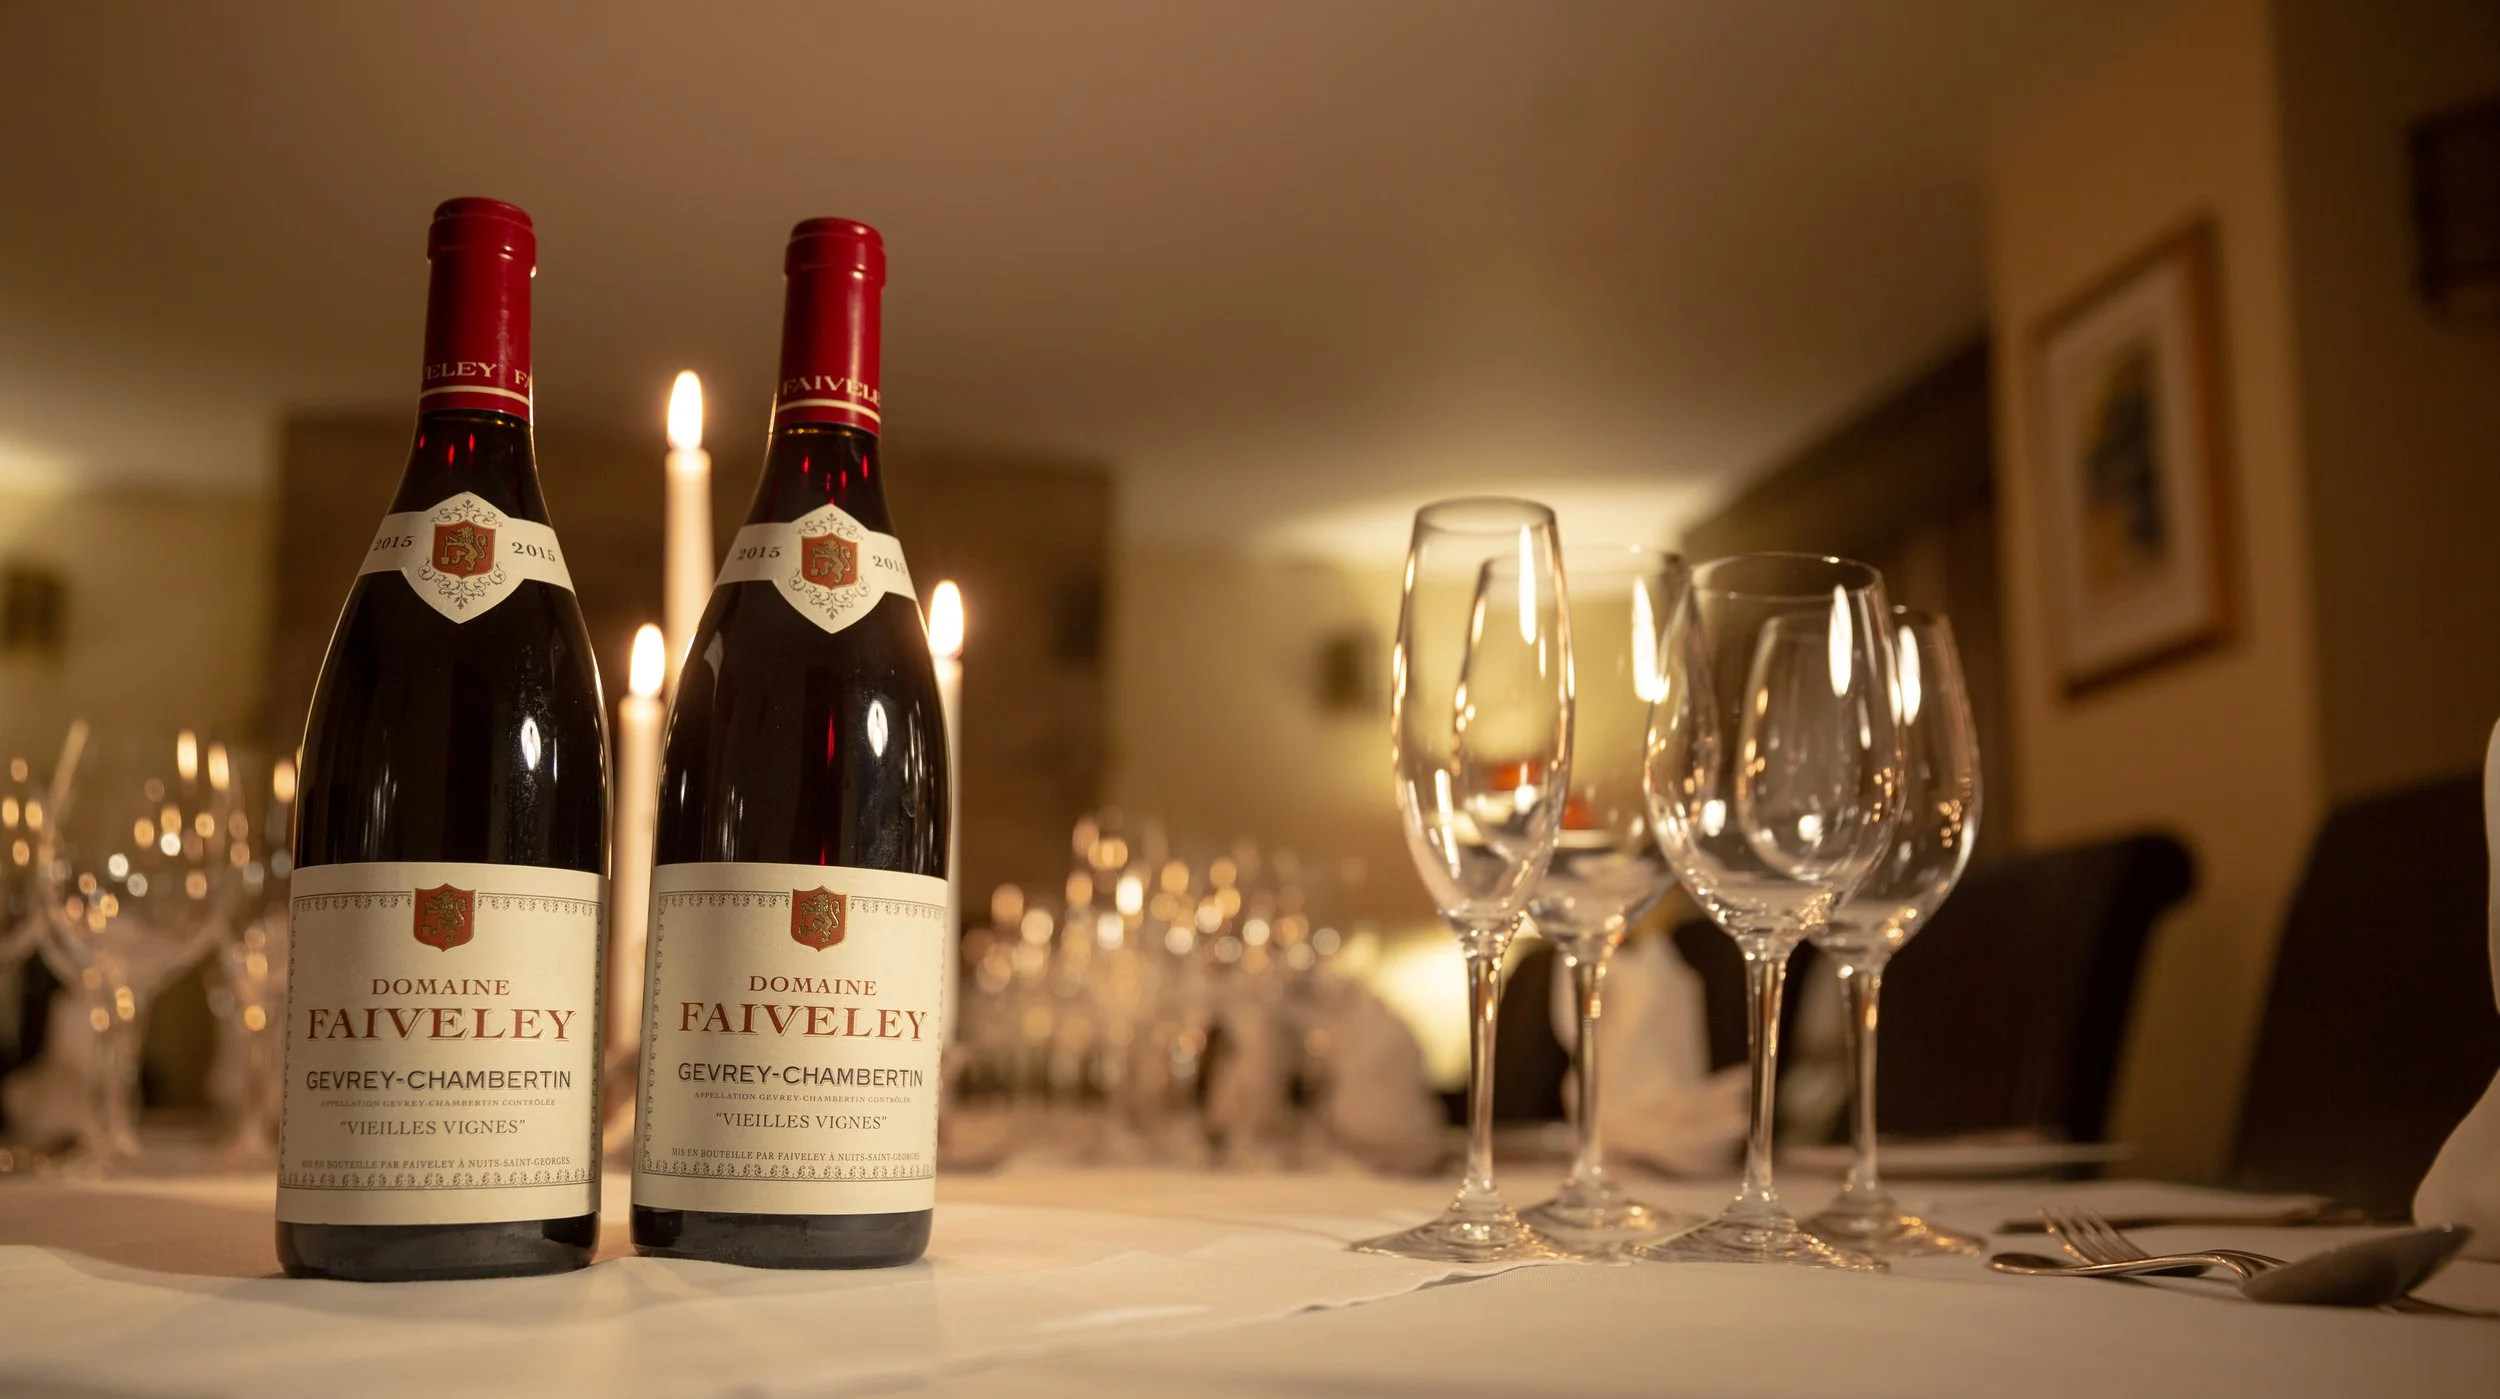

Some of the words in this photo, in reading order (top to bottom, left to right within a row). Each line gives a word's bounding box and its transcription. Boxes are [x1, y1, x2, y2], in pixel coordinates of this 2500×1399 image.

[375, 535, 415, 551] 2015
[511, 541, 556, 562] 2015
[737, 545, 781, 561] 2015
[371, 978, 511, 996] DOMAINE
[749, 975, 877, 996] DOMAINE
[306, 1007, 576, 1042] FAIVELEY
[678, 1002, 928, 1042] FAIVELEY
[306, 1070, 572, 1091] GEVREY-CHAMBERTIN
[678, 1062, 924, 1088] GEVREY-CHAMBERTIN
[382, 1099, 499, 1108] GEVREY-CHAMBERTIN
[694, 1091, 756, 1101] APPELLATION
[759, 1093, 866, 1103] GEVREY-CHAMBERTIN
[327, 1160, 378, 1170] BOUTEILLE
[380, 1160, 400, 1169] PAR
[402, 1159, 455, 1169] FAIVELEY
[457, 1158, 466, 1168] À
[468, 1156, 571, 1169] NUITS-SAINT-GEORGES
[672, 1147, 685, 1157] MIS
[687, 1148, 699, 1157] EN
[701, 1149, 753, 1160] BOUTEILLE
[756, 1151, 775, 1161] PAR
[778, 1151, 827, 1162] FAIVELEY
[828, 1151, 836, 1161] À
